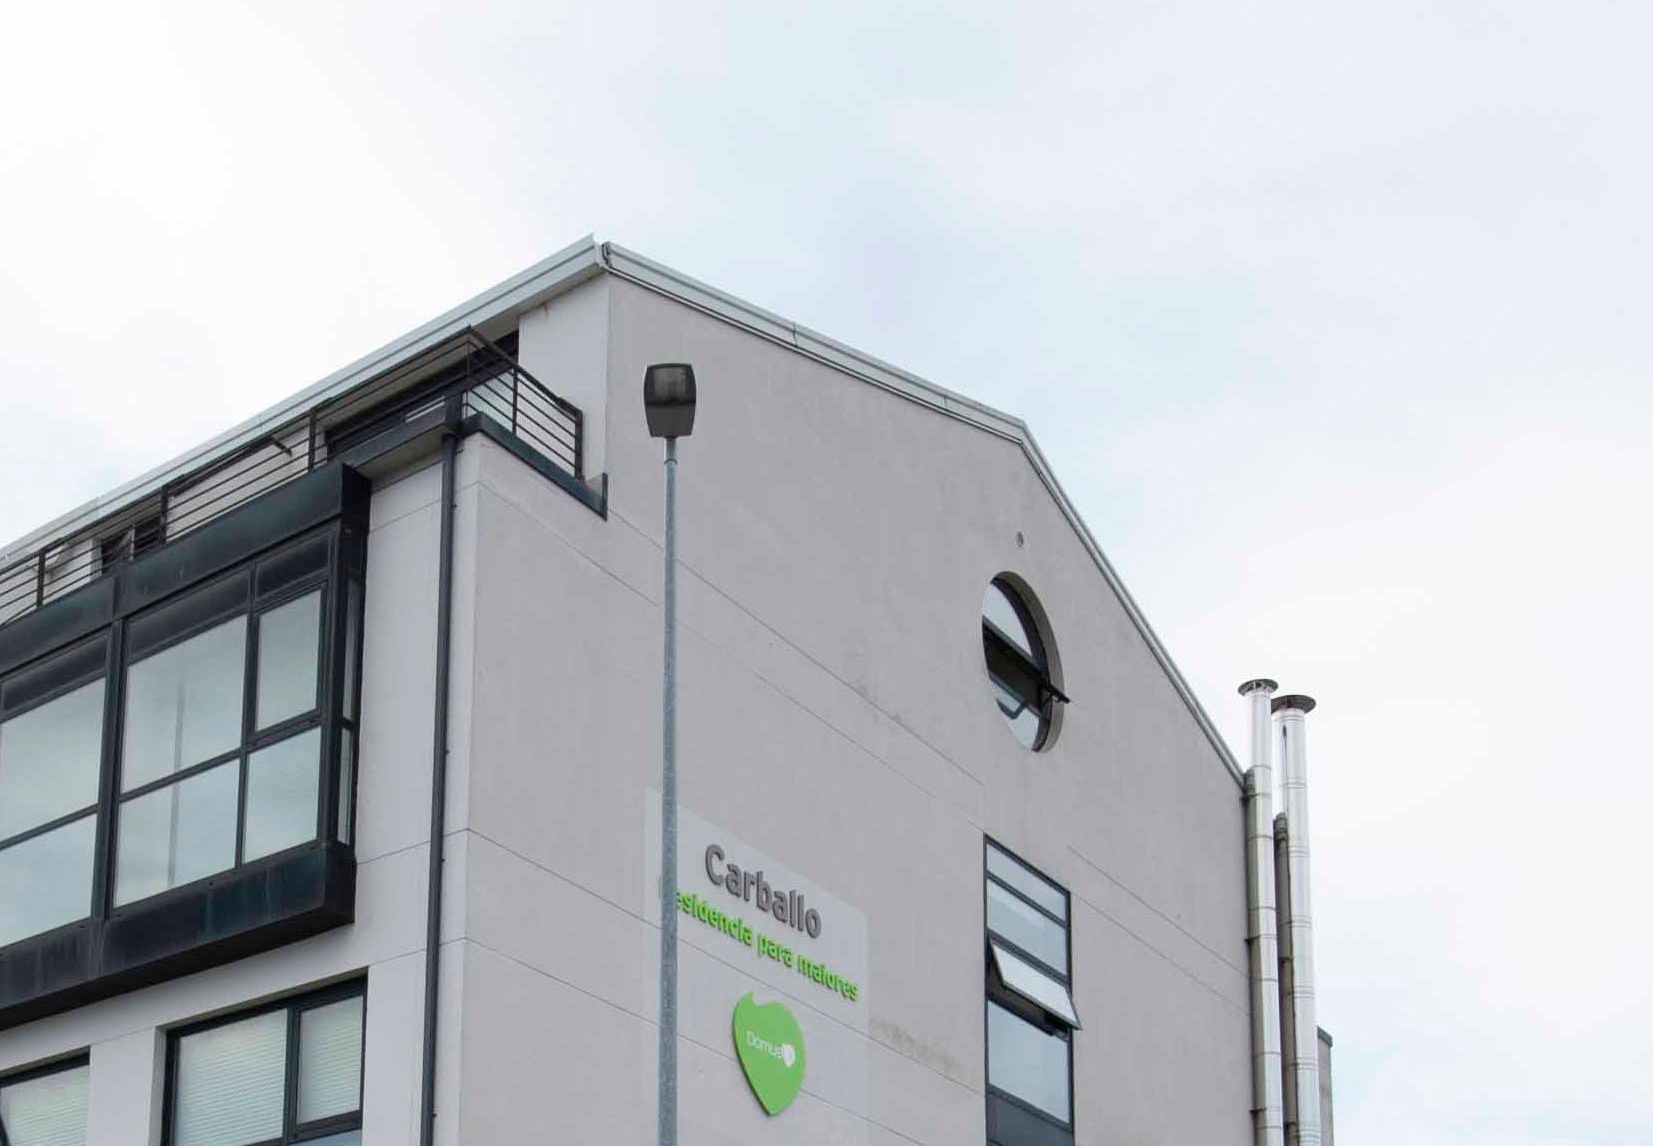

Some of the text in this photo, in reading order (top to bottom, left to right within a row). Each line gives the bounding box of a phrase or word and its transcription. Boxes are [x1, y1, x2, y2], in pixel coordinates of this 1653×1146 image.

[660, 880, 753, 946] esidencia
[757, 933, 792, 968] para
[705, 844, 822, 939] Carballo
